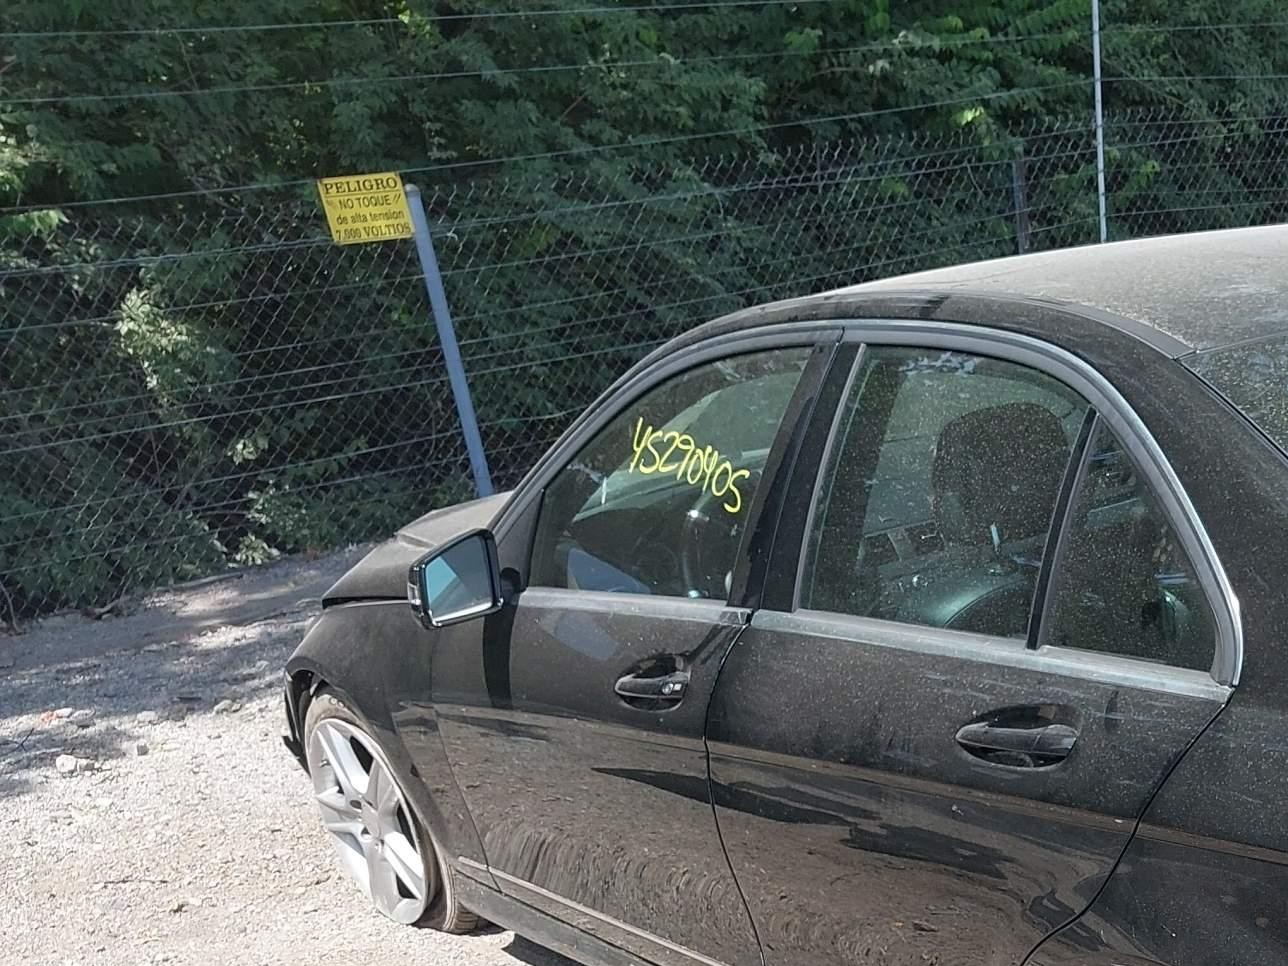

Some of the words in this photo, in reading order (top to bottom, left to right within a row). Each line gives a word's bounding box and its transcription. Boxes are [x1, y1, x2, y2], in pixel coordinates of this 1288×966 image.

[324, 177, 398, 195] PELIGRO
[338, 198, 354, 210] NO
[355, 194, 392, 209] TOQUE
[336, 214, 349, 226] de
[351, 212, 368, 224] alta
[363, 222, 411, 238] VOLTIOS
[629, 416, 750, 513] 45290405
